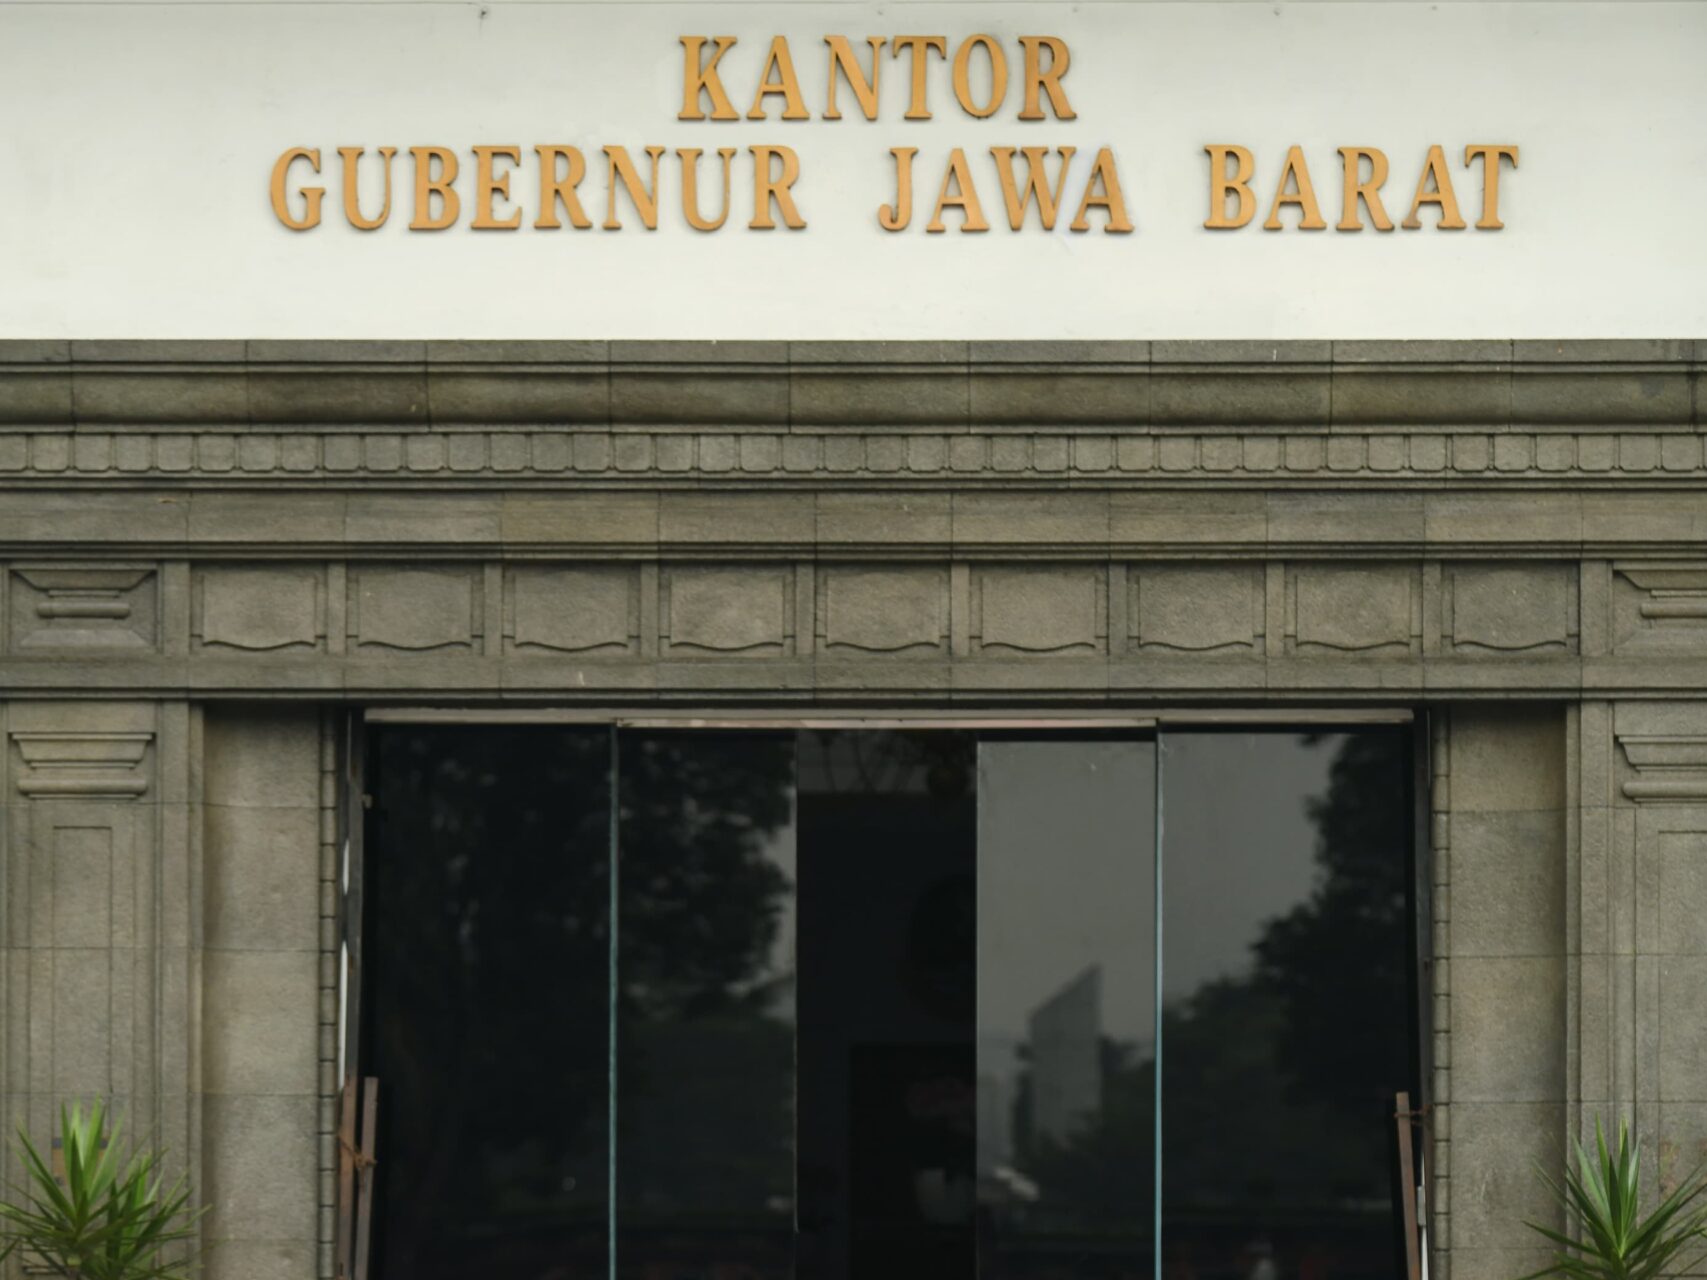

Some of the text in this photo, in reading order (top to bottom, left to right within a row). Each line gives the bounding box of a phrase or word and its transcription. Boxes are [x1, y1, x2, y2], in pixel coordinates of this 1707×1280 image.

[678, 34, 1077, 121] KANTOR
[270, 144, 1519, 233] GUBERNUR JAWA BARAT
